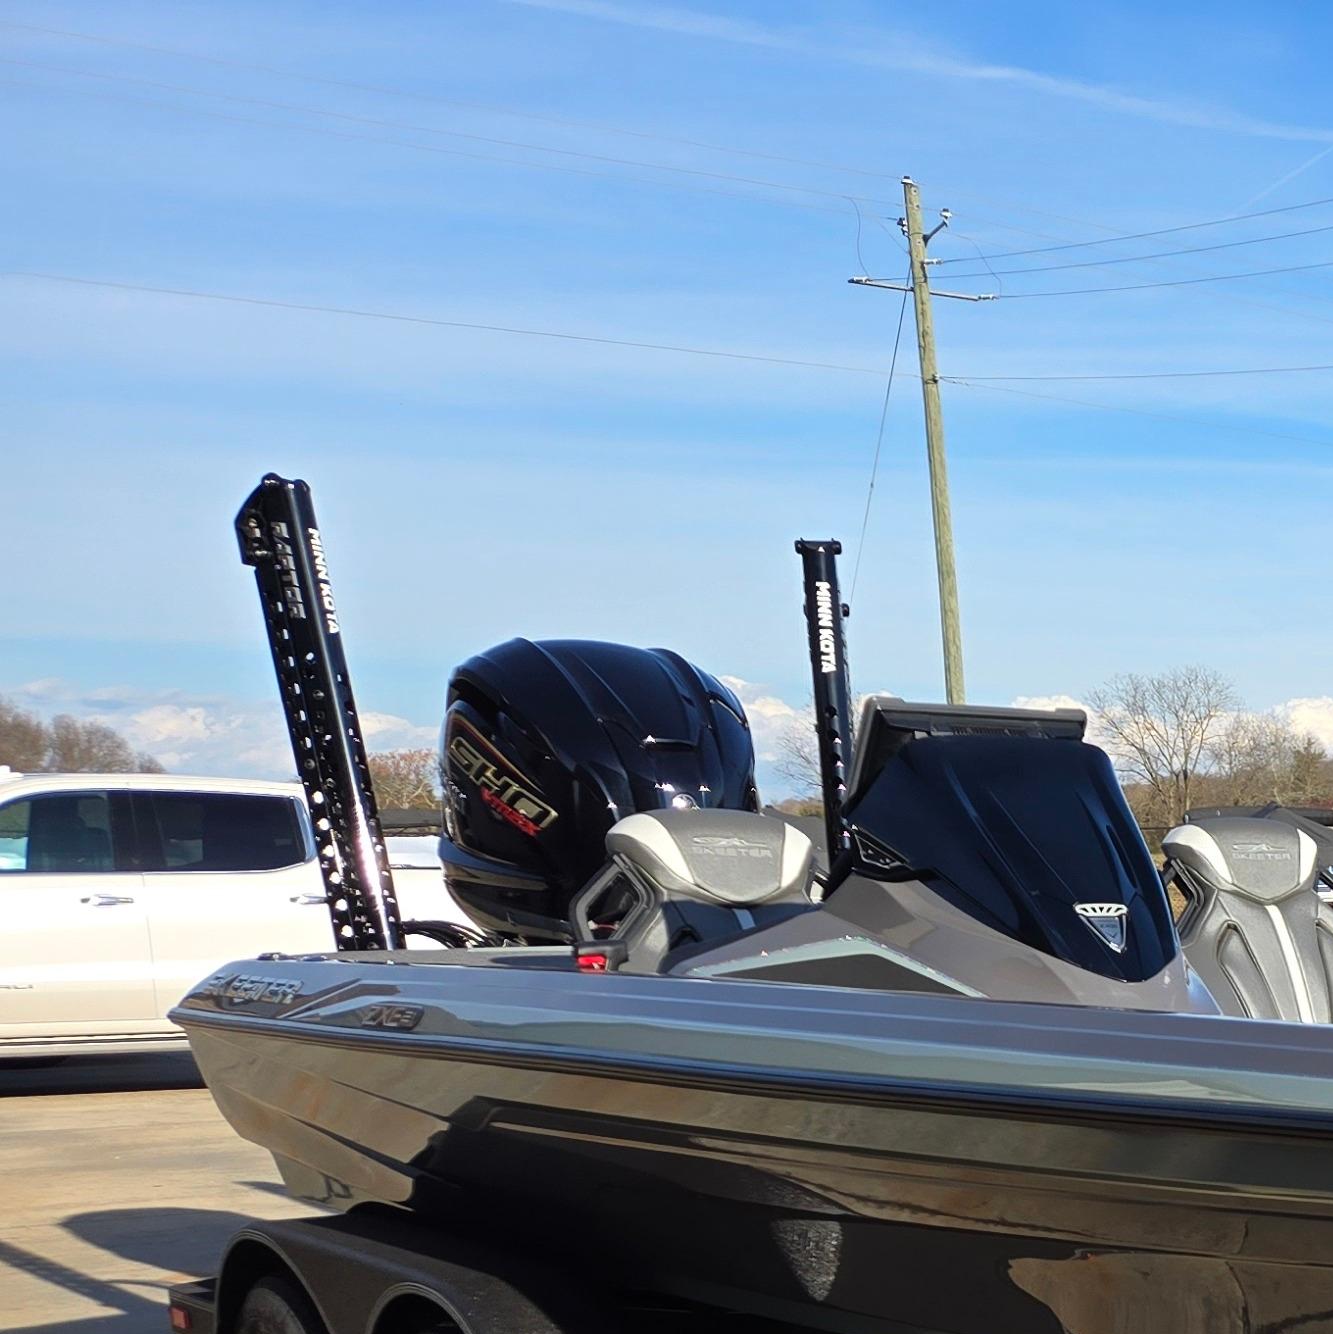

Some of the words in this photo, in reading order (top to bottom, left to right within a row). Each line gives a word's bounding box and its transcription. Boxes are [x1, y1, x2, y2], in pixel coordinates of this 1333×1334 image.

[307, 527, 330, 581] MINN
[319, 582, 340, 634] KOTA
[815, 581, 833, 628] MINN
[819, 628, 837, 673] KOTA
[691, 846, 773, 858] SKEETER
[1231, 853, 1291, 861] SKEETER
[207, 974, 304, 1004] SKEETER
